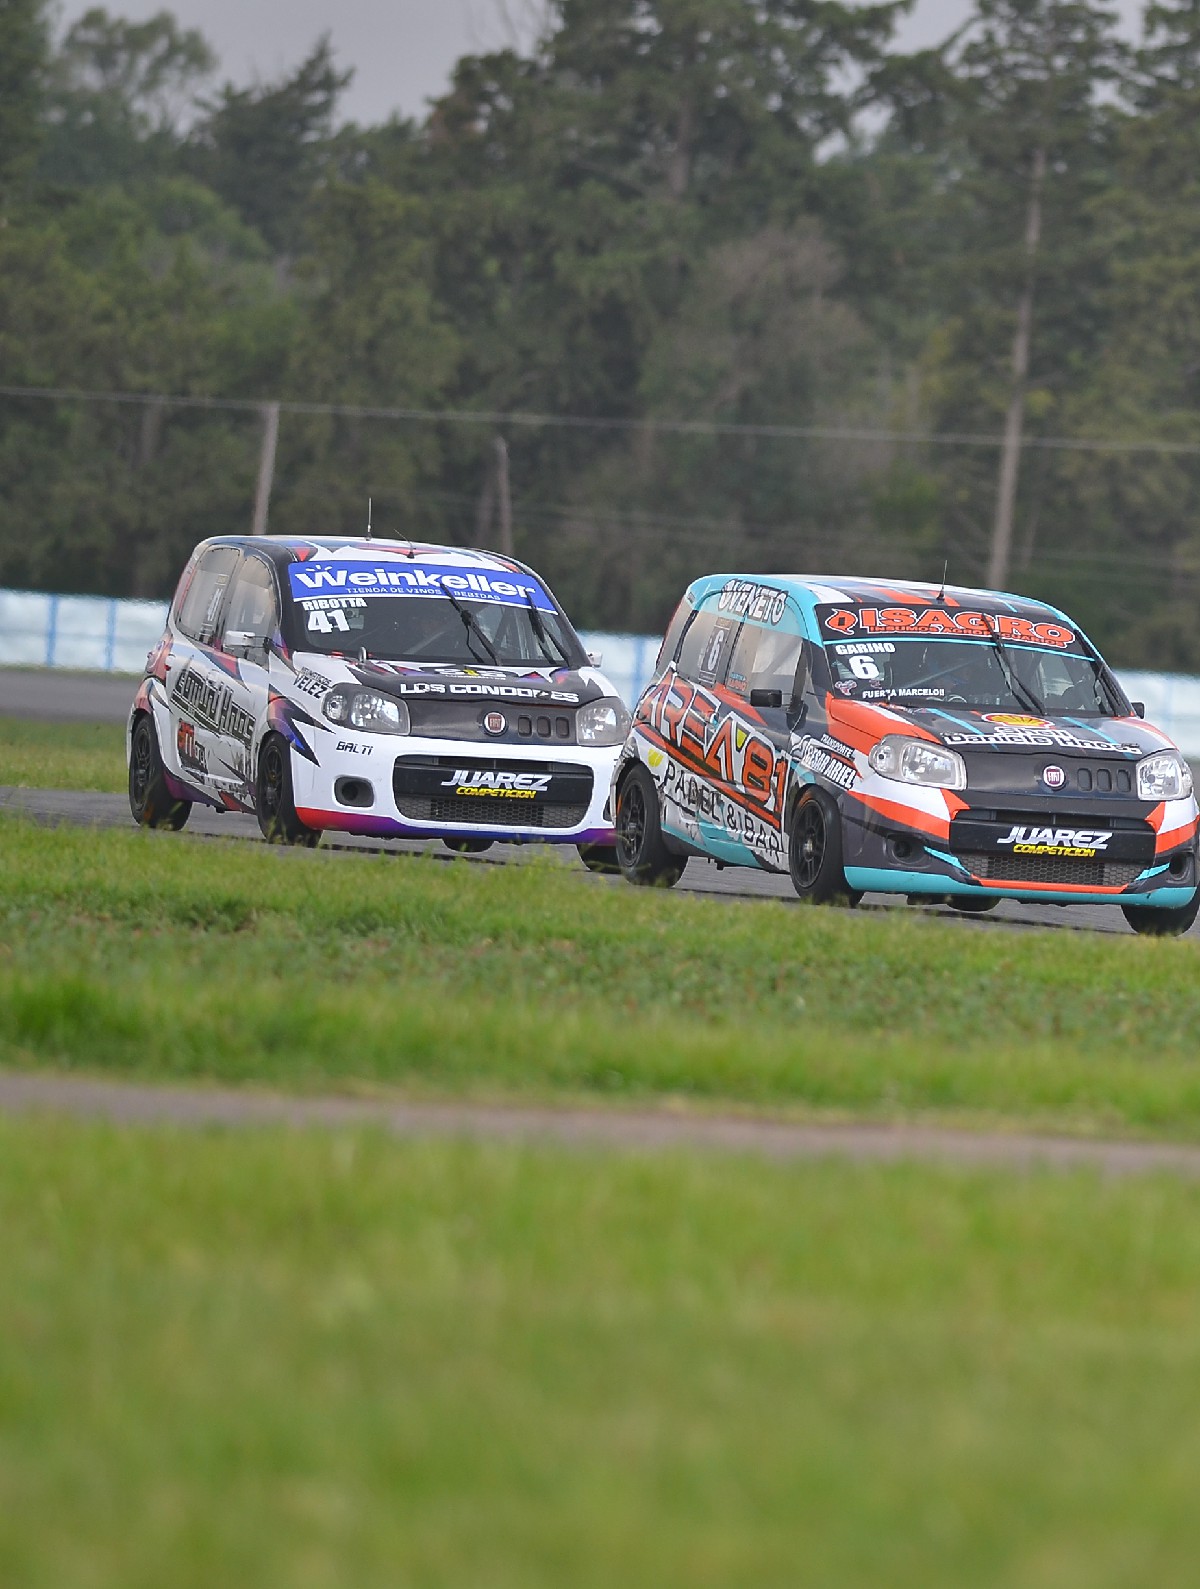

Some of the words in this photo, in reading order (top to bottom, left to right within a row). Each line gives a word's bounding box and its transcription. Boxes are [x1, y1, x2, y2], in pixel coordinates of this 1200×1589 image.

[295, 566, 536, 597] Weinkeller
[302, 597, 368, 611] RIBOTTA
[453, 590, 501, 600] BEBIDAS
[307, 609, 350, 633] 41
[869, 625, 939, 634] INSUMOS
[943, 627, 1067, 648] AGROPCUARIOS
[835, 642, 896, 655] GARINO
[848, 655, 880, 679] 6
[293, 674, 328, 699] VELEZ
[400, 683, 445, 695] LOS
[441, 769, 553, 791] JUAREZ
[823, 757, 857, 790] ARIEL
[456, 787, 537, 798] COMPETICION
[726, 803, 738, 832] &
[998, 826, 1113, 850] JUAREZ
[1012, 843, 1096, 857] COMPETICION
